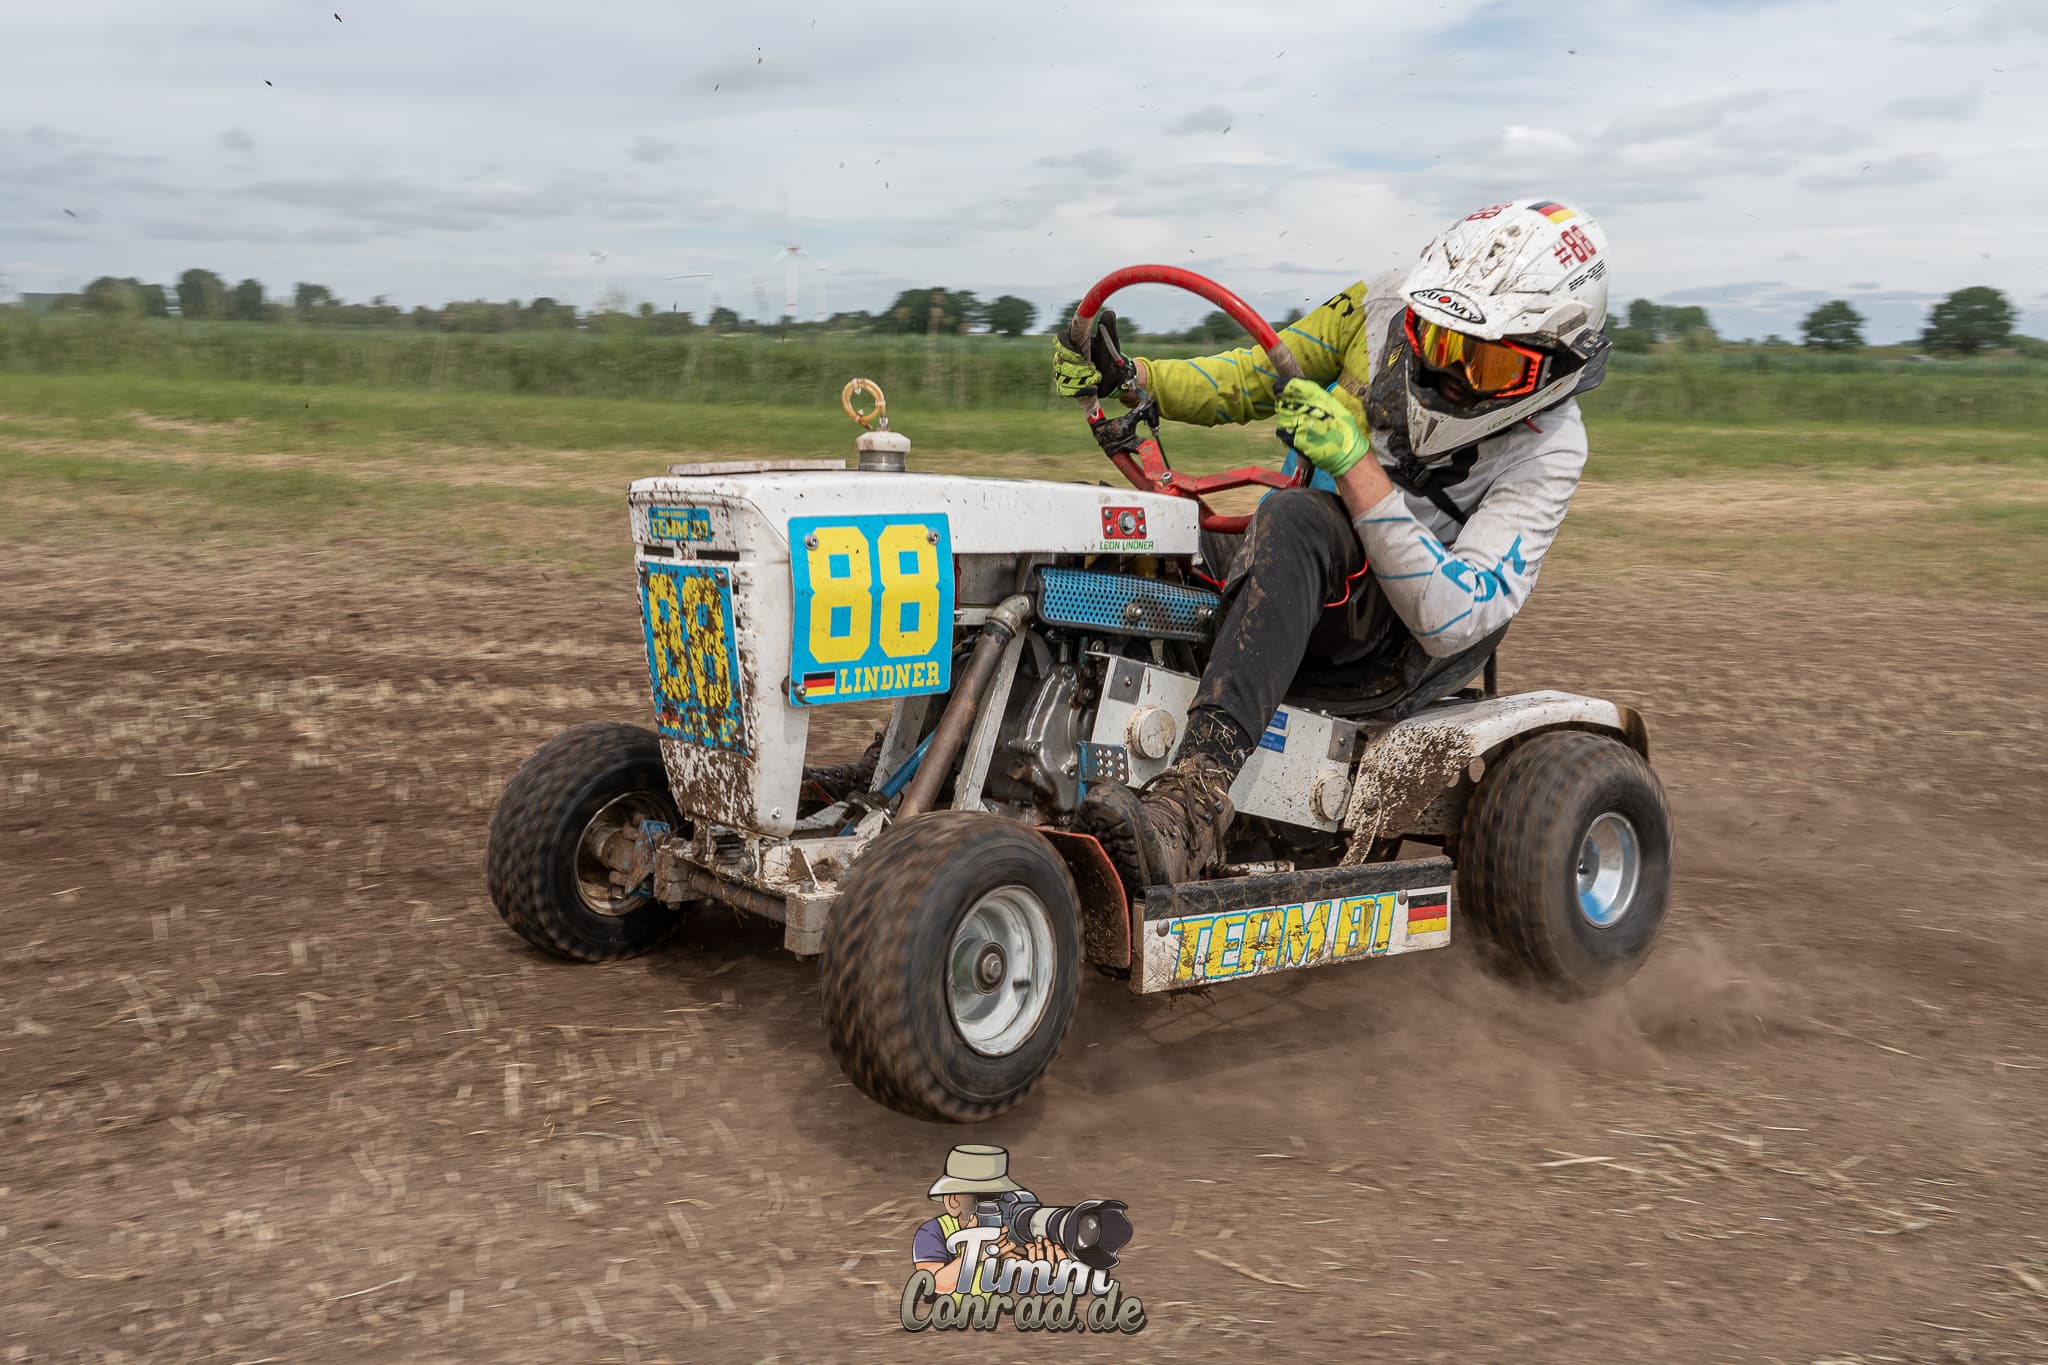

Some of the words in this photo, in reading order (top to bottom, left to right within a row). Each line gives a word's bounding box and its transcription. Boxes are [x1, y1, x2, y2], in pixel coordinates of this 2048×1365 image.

[1100, 541, 1120, 550] LEON
[1122, 541, 1154, 551] LINDNER
[806, 524, 941, 664] 88
[648, 573, 732, 709] 88
[839, 660, 940, 694] LINDNER
[1170, 900, 1332, 984] TEAM
